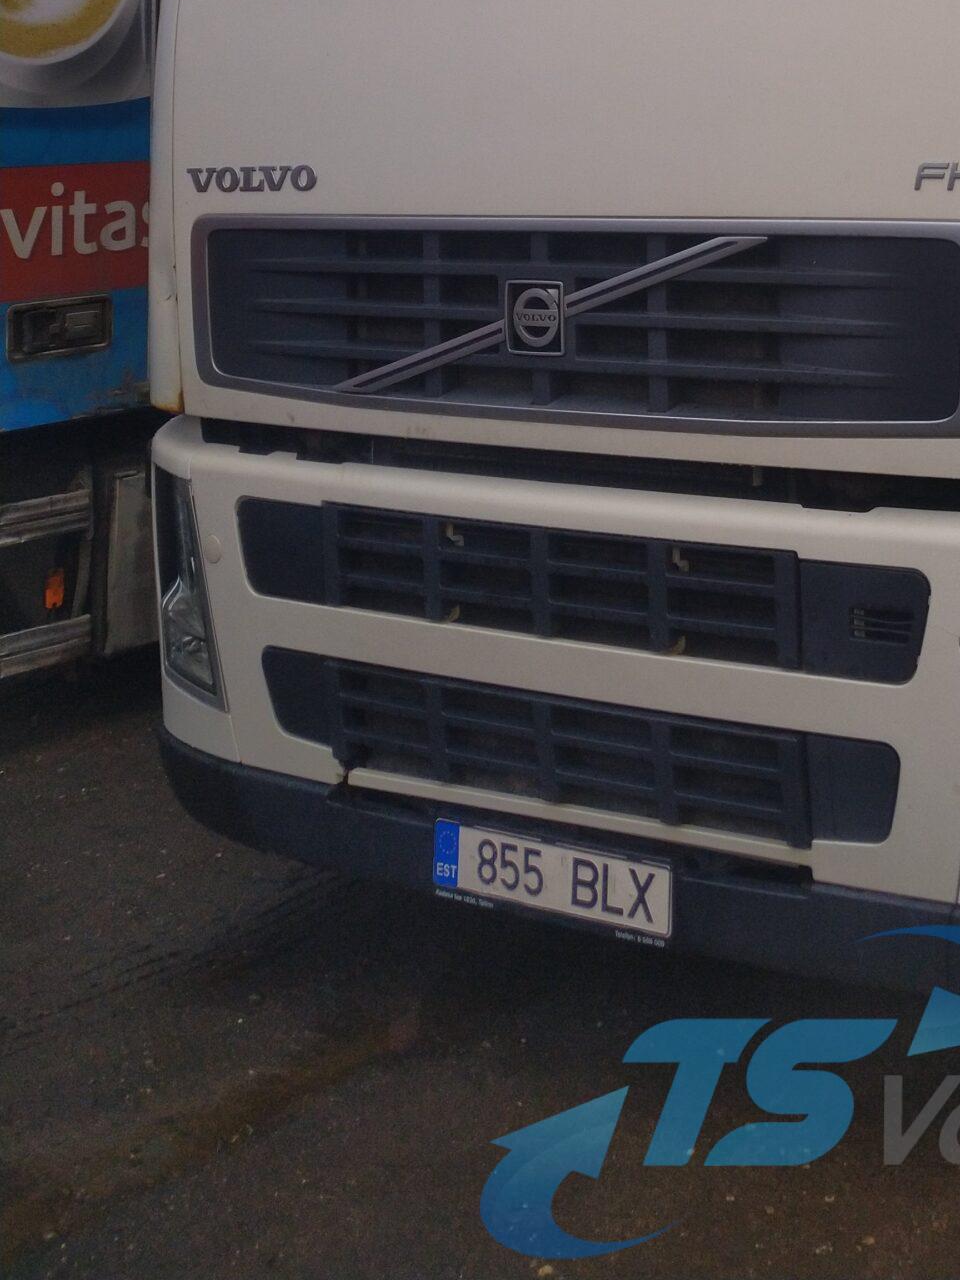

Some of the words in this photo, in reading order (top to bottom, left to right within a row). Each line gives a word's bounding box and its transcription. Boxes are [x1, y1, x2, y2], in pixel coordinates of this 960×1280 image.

[187, 164, 317, 192] VOLVO
[516, 313, 556, 322] VOLVO
[436, 862, 457, 879] EST
[477, 838, 544, 896] 855
[570, 856, 656, 923] BLX
